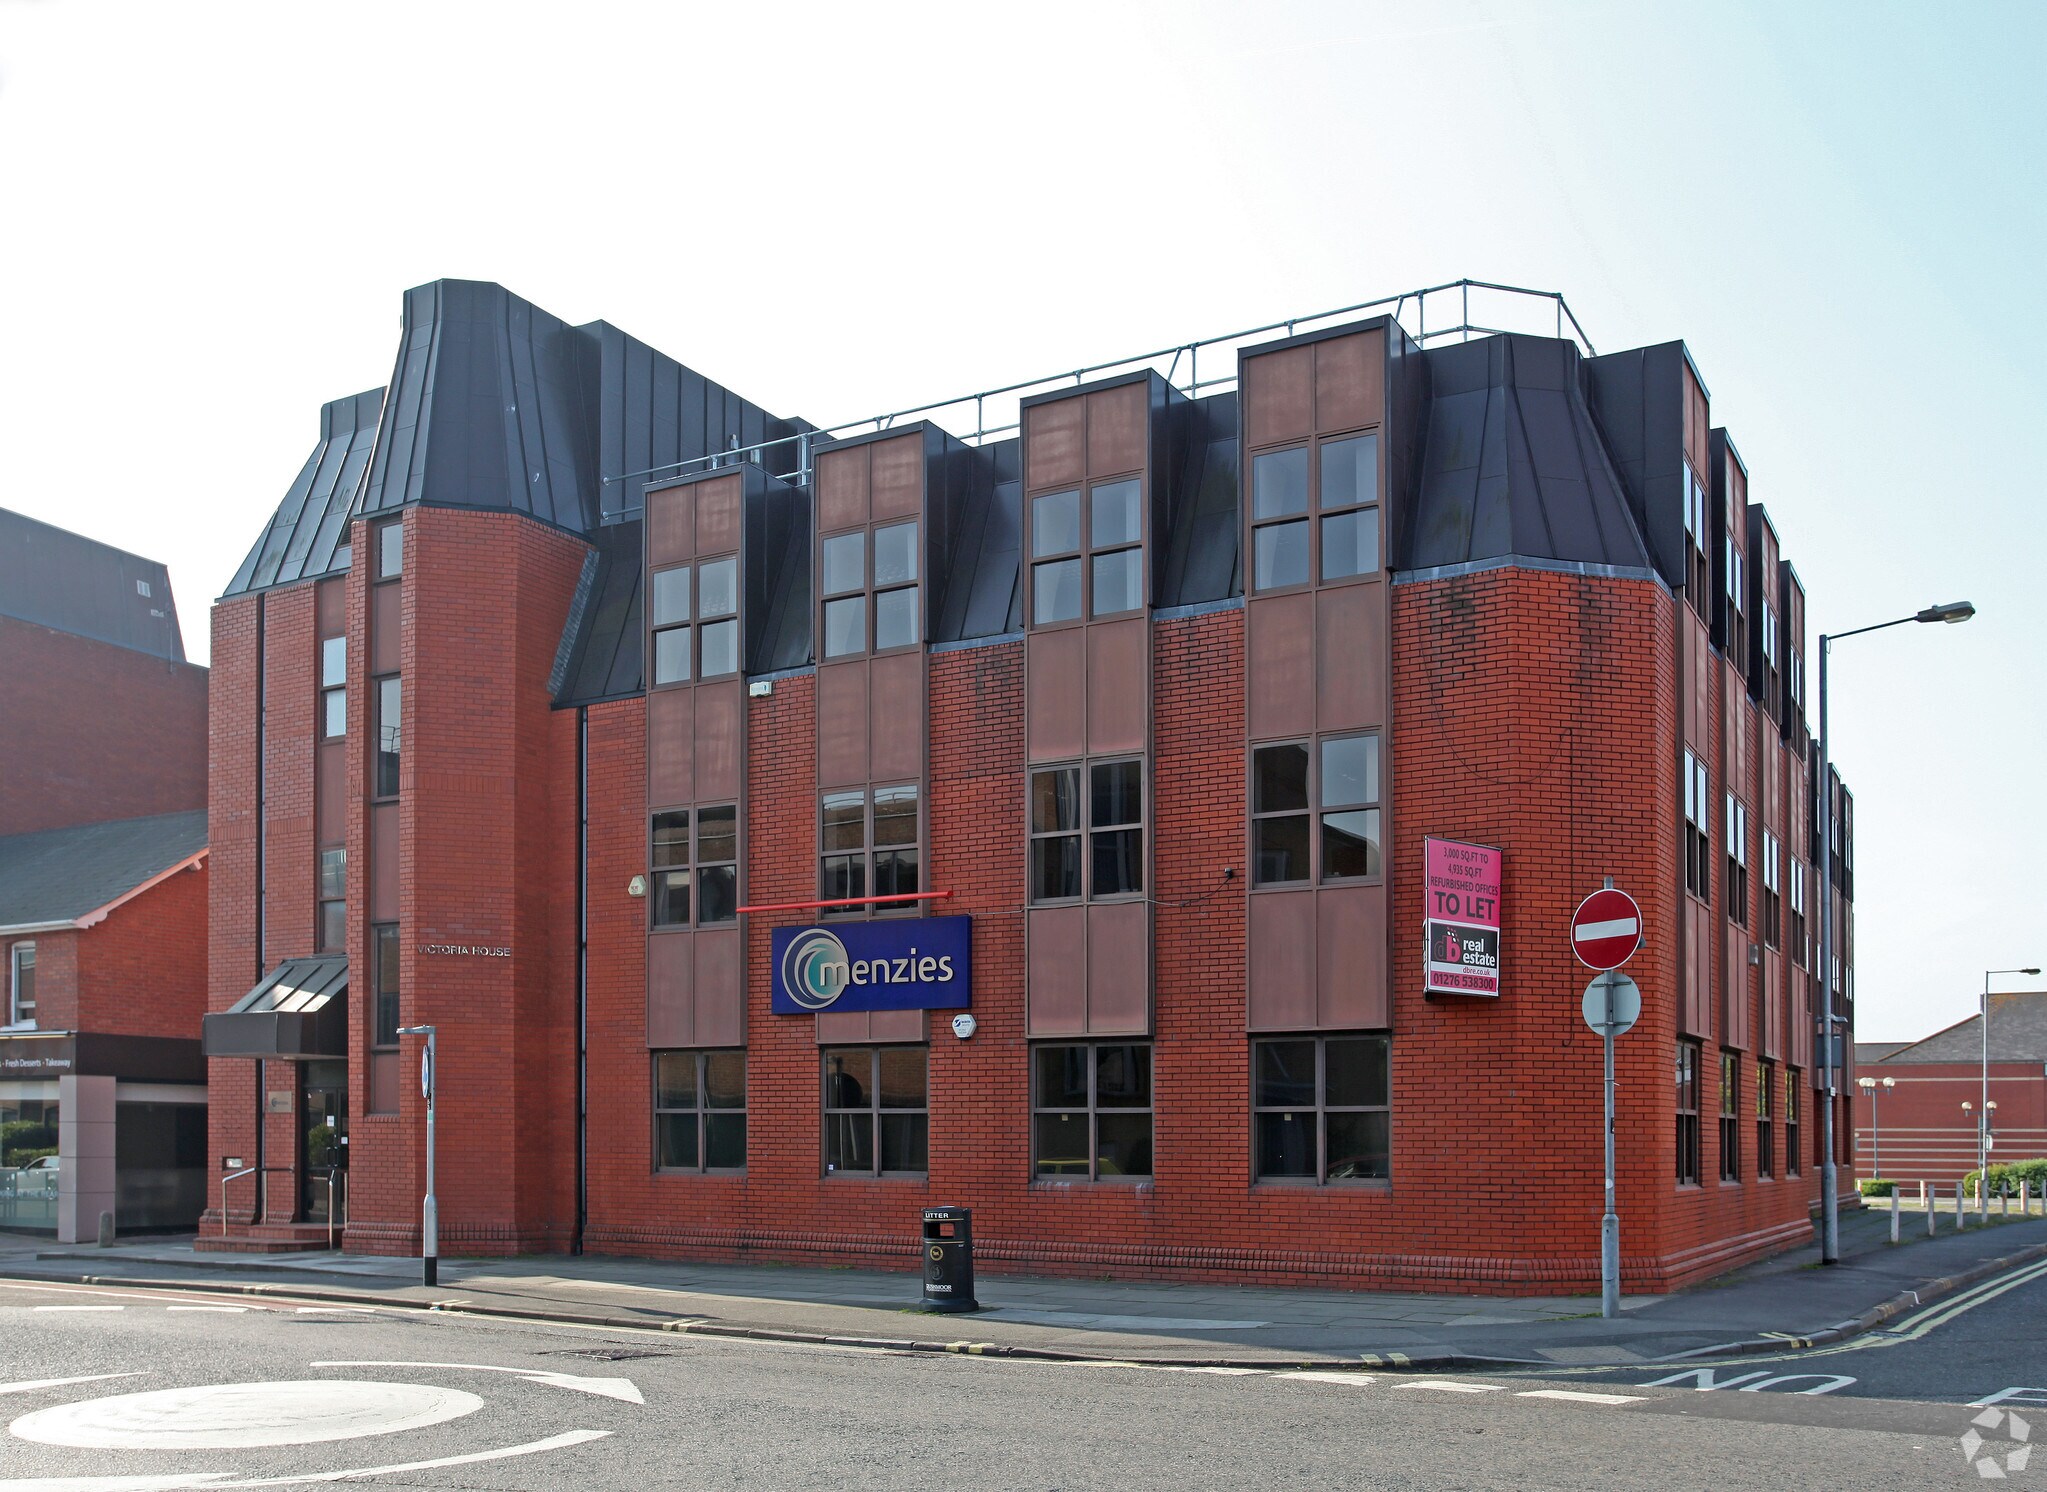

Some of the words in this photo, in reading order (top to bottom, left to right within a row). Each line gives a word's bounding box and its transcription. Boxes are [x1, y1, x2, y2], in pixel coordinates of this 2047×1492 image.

[1443, 847, 1460, 860] 3,000
[1480, 854, 1489, 864] TO
[1448, 864, 1463, 875] 4,935
[1430, 876, 1474, 892] REFURBISHED
[1475, 883, 1498, 896] OFFICES
[1434, 891, 1460, 915] TO
[1466, 896, 1495, 920] LET
[417, 944, 469, 955] VICTORIA
[472, 946, 511, 957] HOUSE
[1463, 938, 1484, 952] real
[820, 948, 954, 987] menzies
[1462, 952, 1495, 967] estate
[1462, 966, 1491, 976] dbre.co.uk
[1433, 973, 1460, 987] 01276
[1462, 976, 1494, 990] 538300
[5, 1059, 20, 1068] Fresh
[20, 1058, 41, 1068] Desserts
[45, 1057, 72, 1068] Takeaway
[1635, 1368, 1858, 1396] NO
